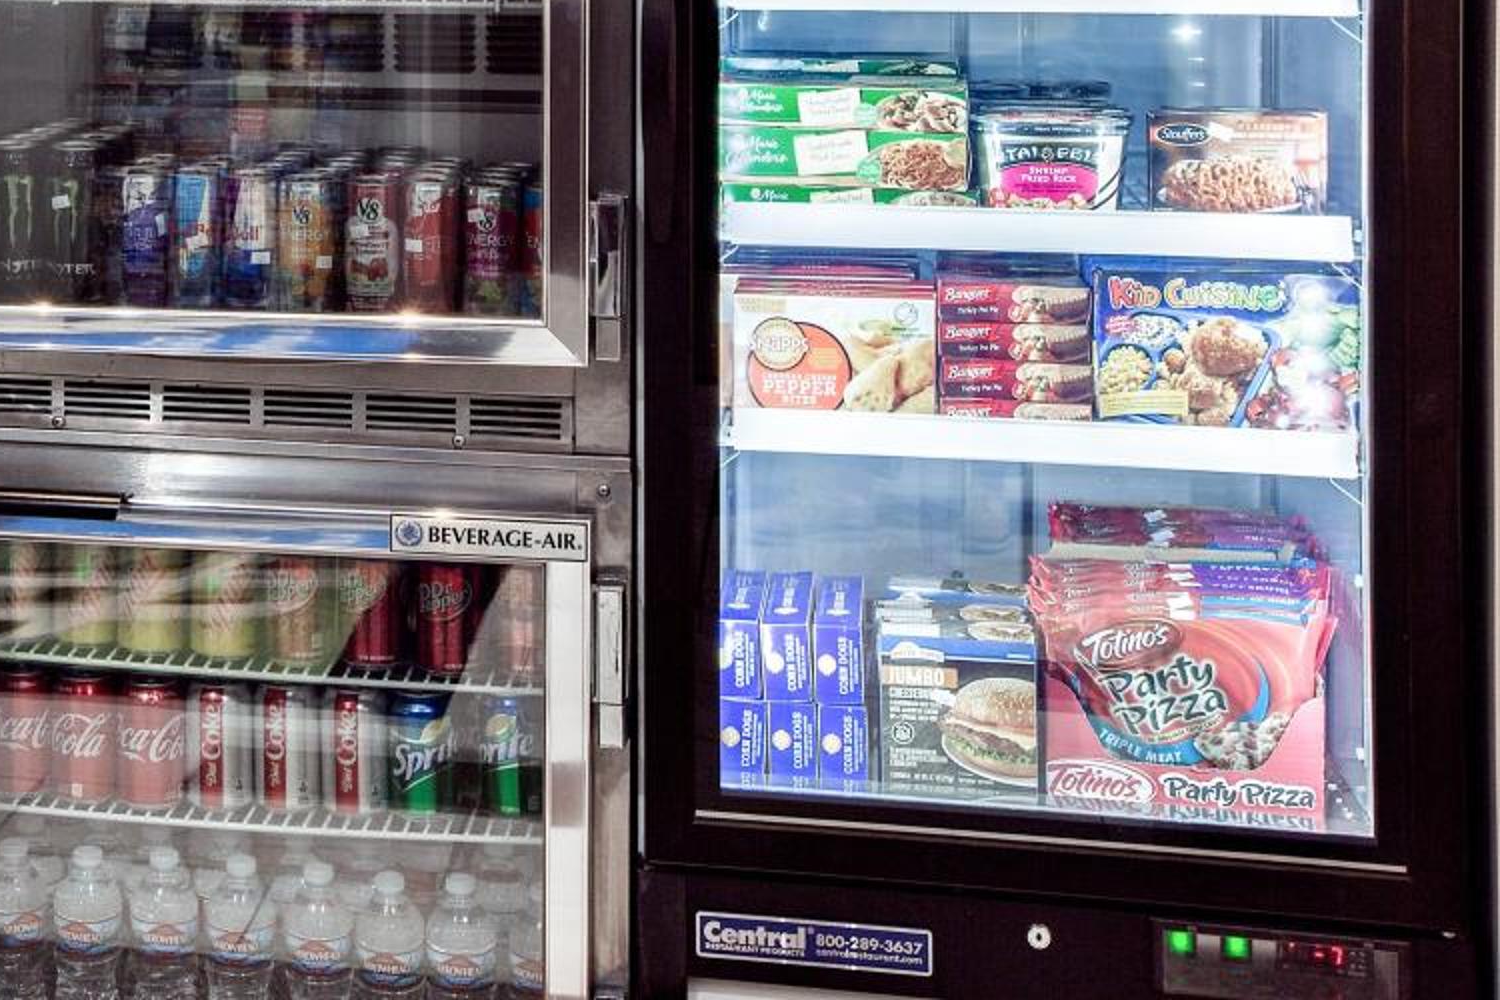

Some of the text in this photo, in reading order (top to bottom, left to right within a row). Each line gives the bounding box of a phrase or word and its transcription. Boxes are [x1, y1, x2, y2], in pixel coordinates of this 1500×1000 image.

[1028, 166, 1069, 175] SHRIMP
[1053, 175, 1078, 184] RICE
[356, 199, 381, 221] V8
[762, 380, 837, 397] PEPPER
[428, 526, 578, 550] BEVERAGE-AIR
[1080, 619, 1171, 666] Totino's
[889, 666, 945, 686] JUMBO
[1099, 653, 1216, 704] Party
[1114, 686, 1228, 735] Pizza
[201, 704, 221, 761] Coke
[266, 704, 286, 761] Coke
[336, 708, 358, 767] Coke
[1146, 749, 1182, 762] MEAT
[1047, 764, 1316, 809] Totino's Party Pizza
[703, 919, 807, 949] Central
[815, 932, 923, 956] 800-289-3637
